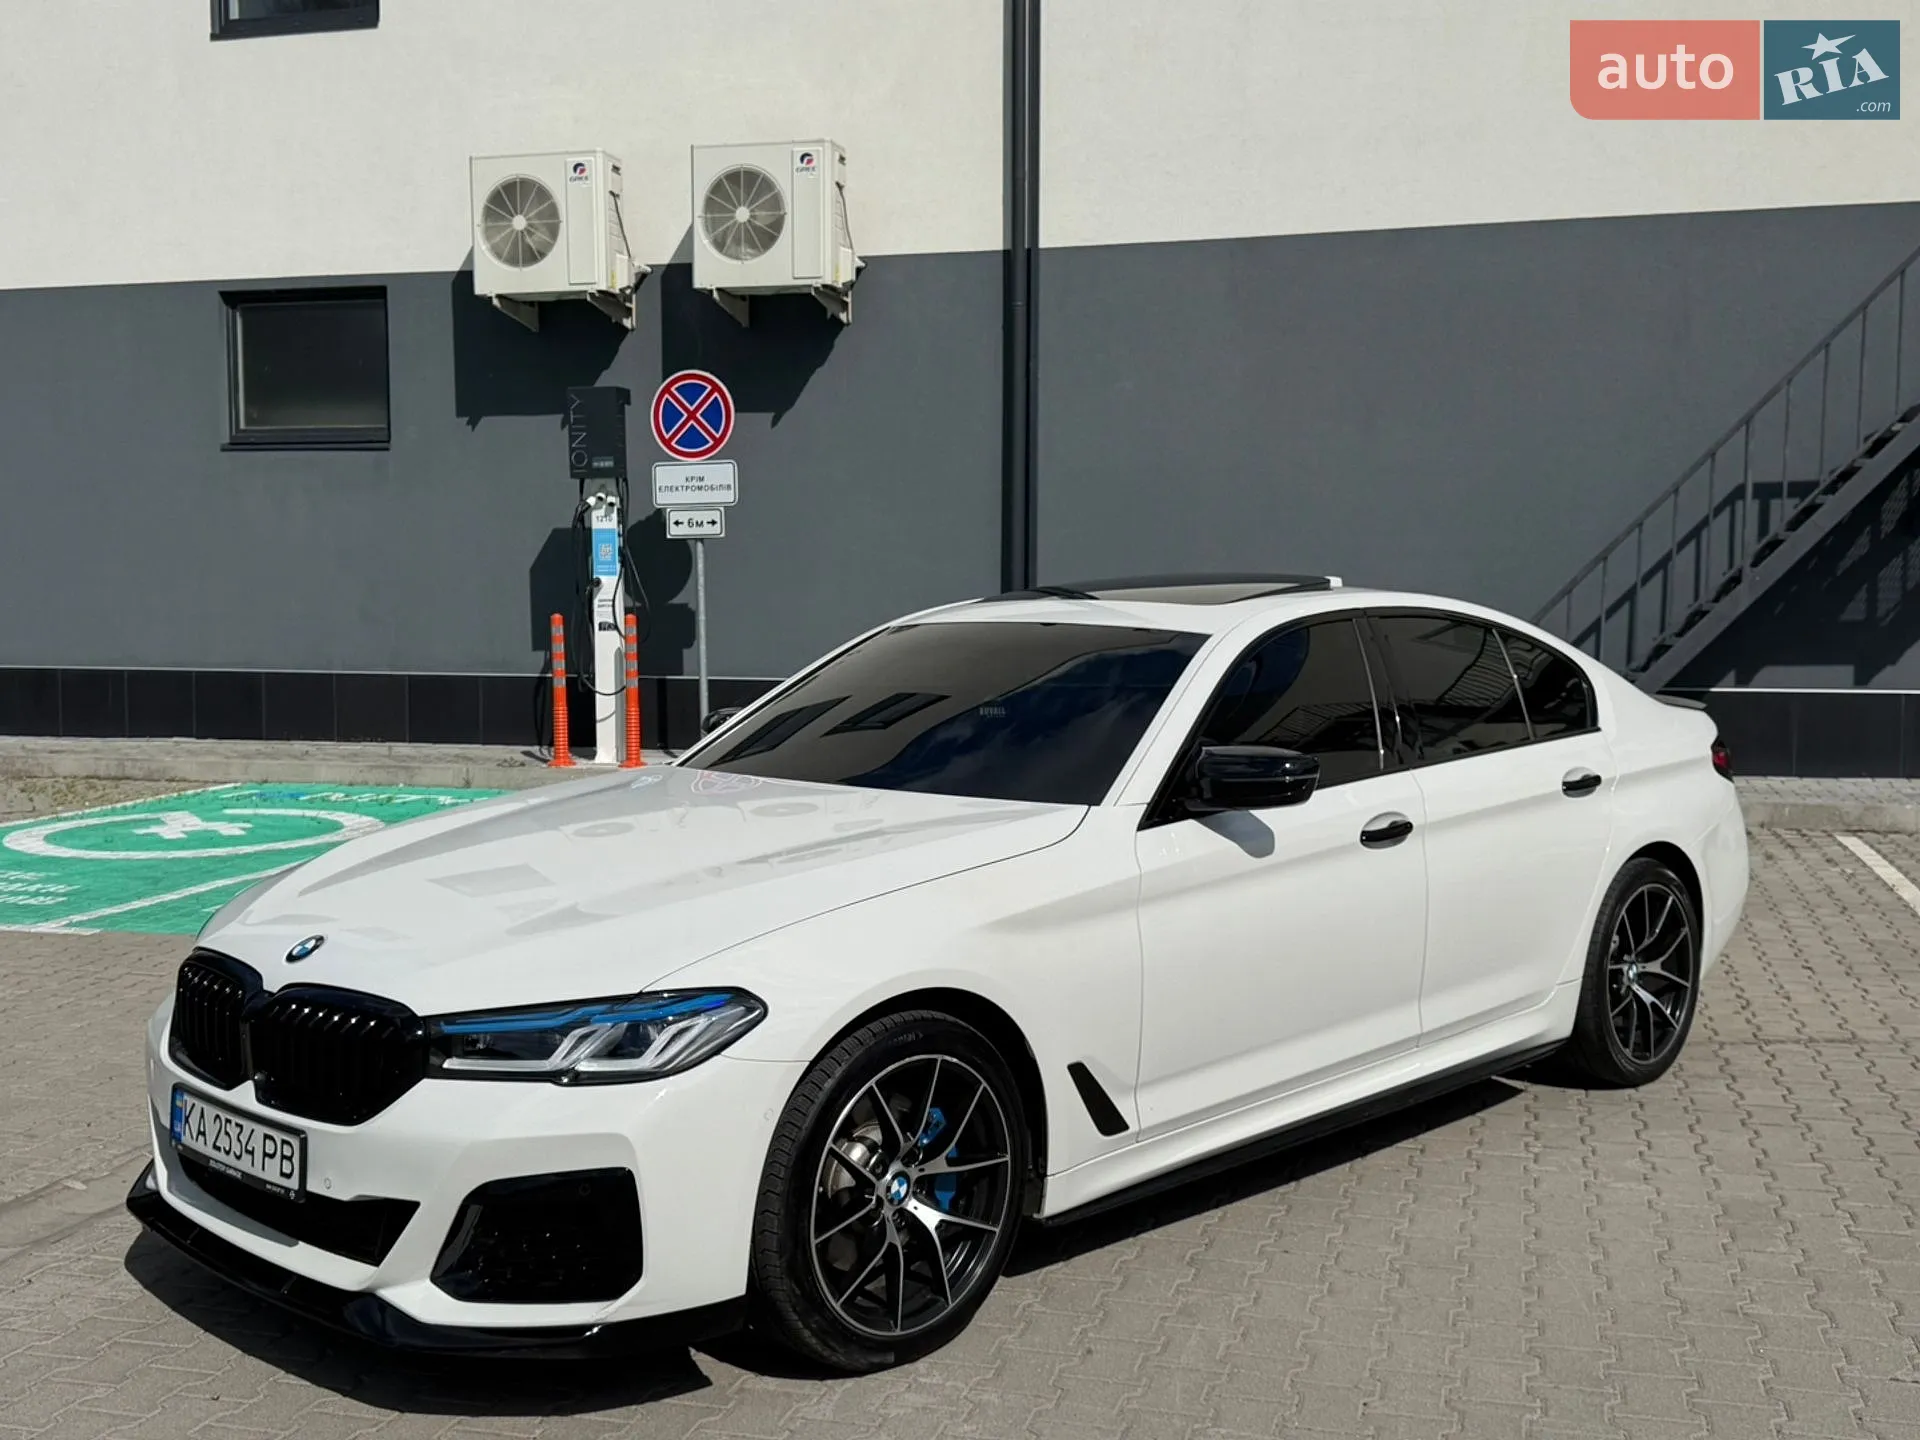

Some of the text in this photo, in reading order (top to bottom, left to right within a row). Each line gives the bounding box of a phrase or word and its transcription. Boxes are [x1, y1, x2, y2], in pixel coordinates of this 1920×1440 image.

[569, 394, 588, 473] IONITY
[658, 484, 733, 493] ЕЛЕКТРОМОБІЛІВ
[685, 475, 705, 483] КРІМ
[183, 1099, 208, 1147] KA
[212, 1113, 256, 1169] 2534
[262, 1132, 295, 1180] PB
